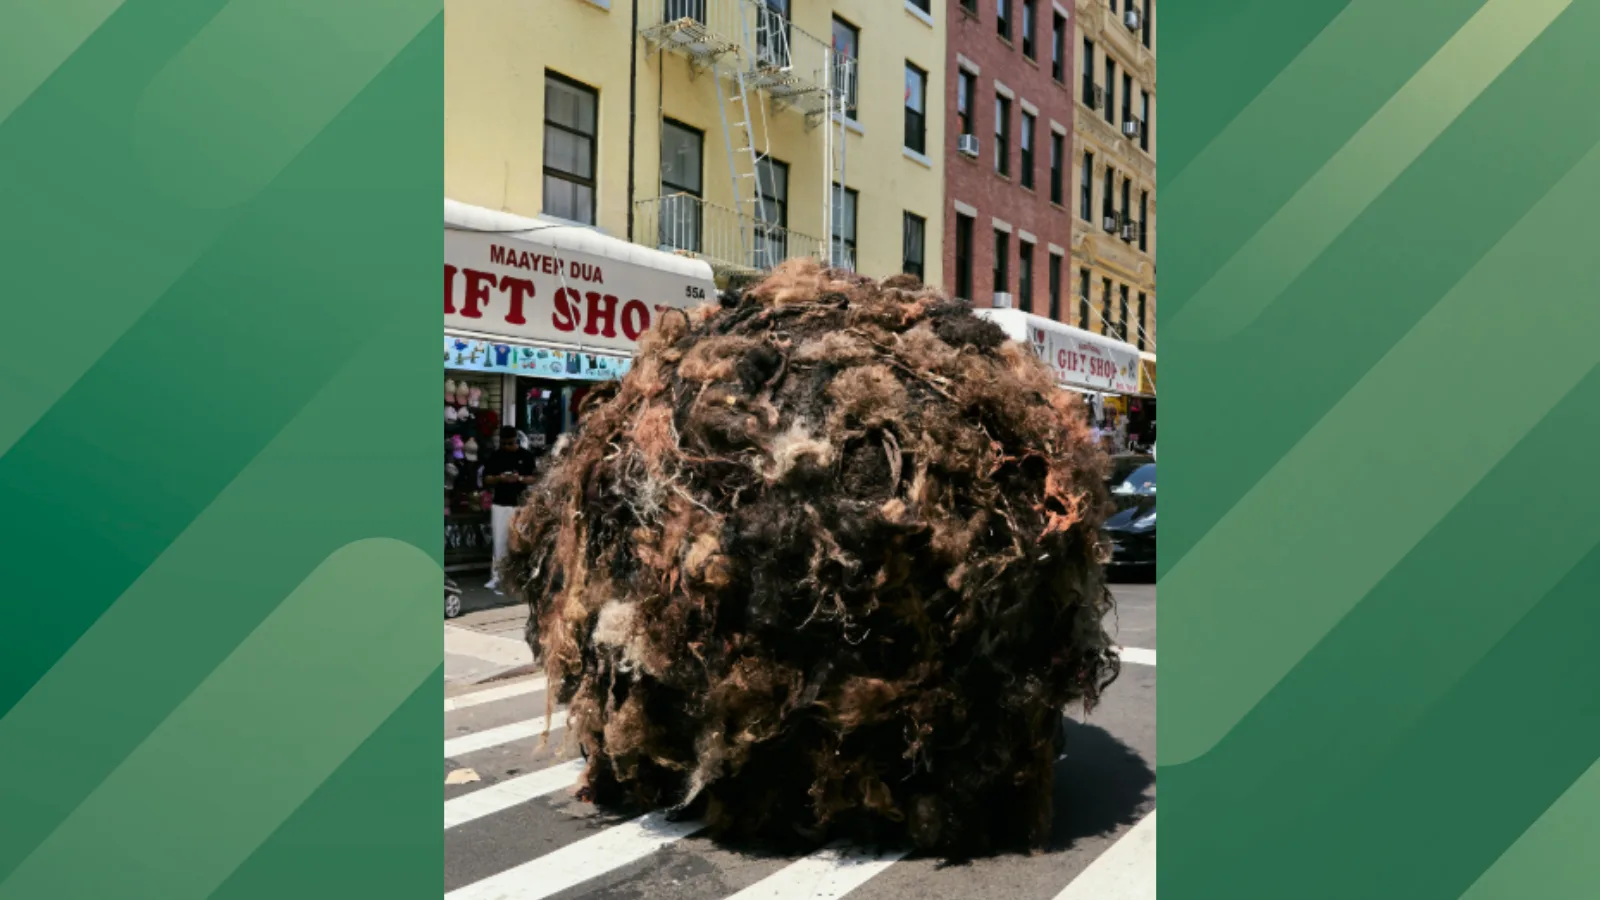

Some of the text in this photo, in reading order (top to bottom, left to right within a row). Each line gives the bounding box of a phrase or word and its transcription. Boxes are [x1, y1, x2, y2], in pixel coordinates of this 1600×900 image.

[490, 244, 604, 284] MAAYER DUA
[552, 287, 668, 341] SHO
[1057, 348, 1087, 374] GIFT
[1090, 356, 1118, 379] SHOP
